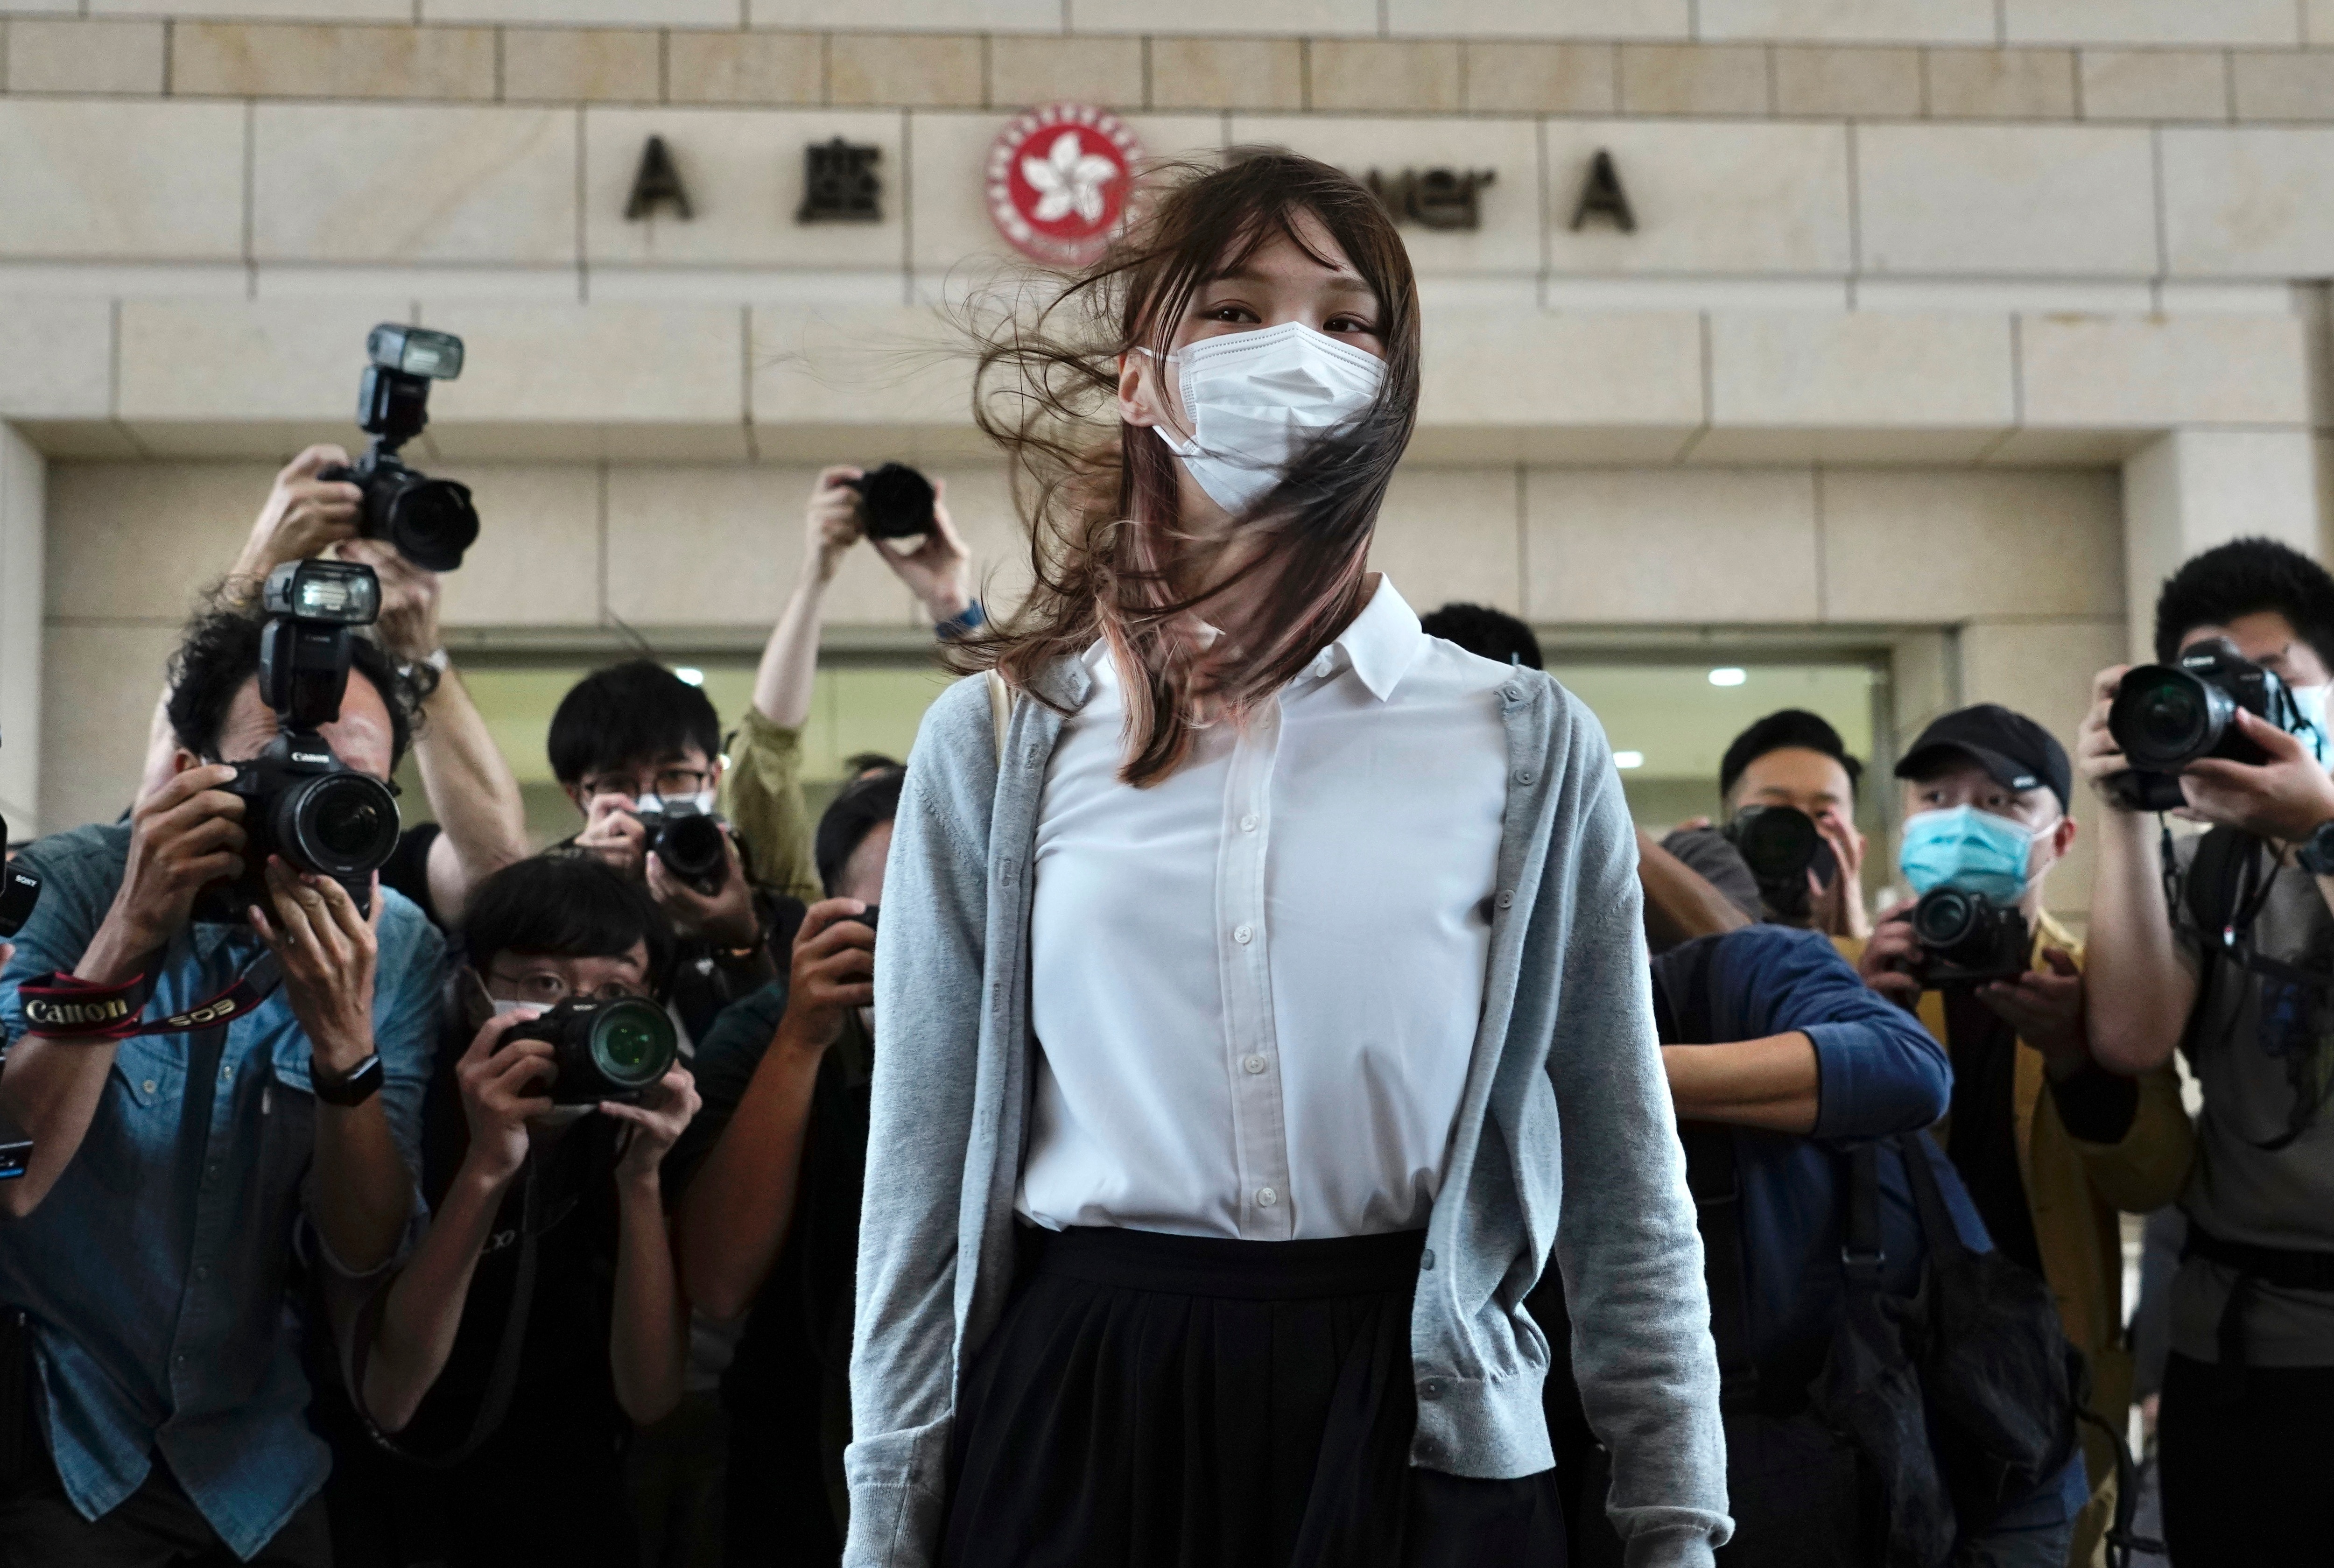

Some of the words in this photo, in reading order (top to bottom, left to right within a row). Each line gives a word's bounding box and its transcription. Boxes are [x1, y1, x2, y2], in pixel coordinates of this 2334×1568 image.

[623, 134, 692, 218] A
[1570, 149, 1636, 230] A
[26, 999, 127, 1024] Canon
